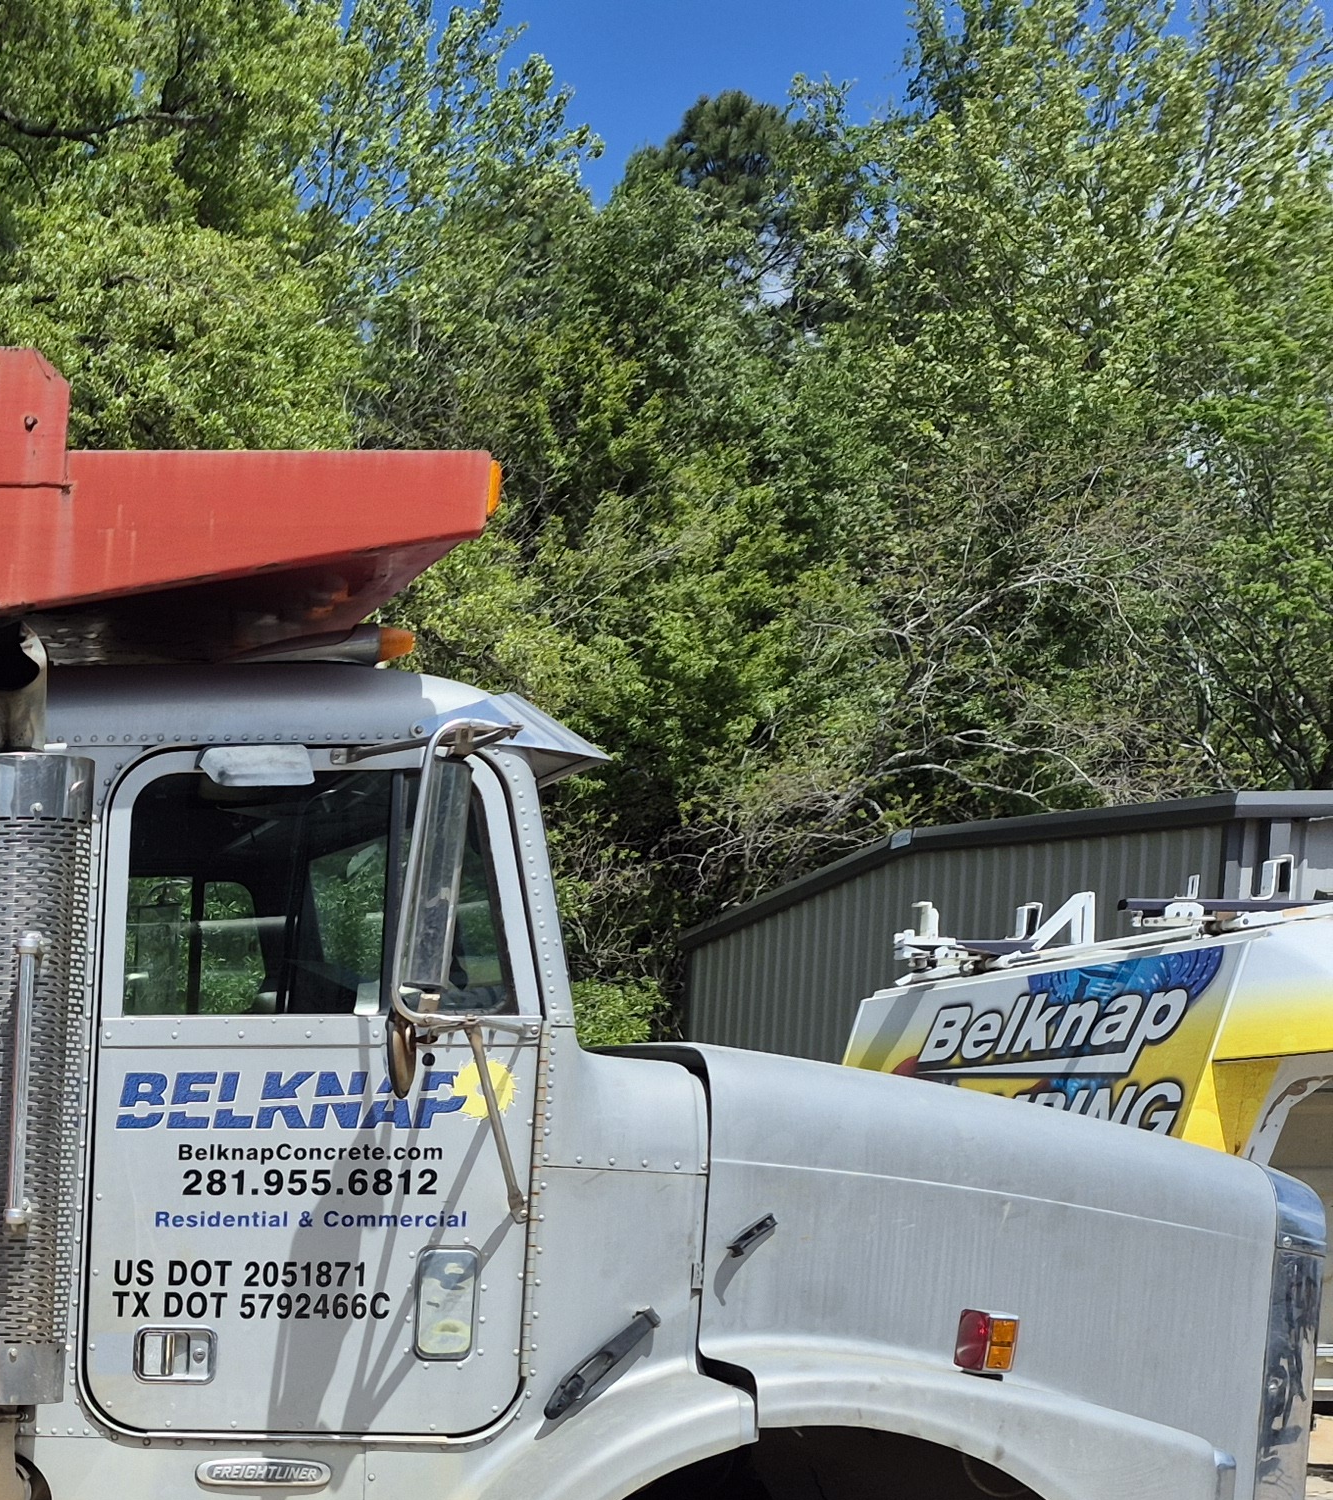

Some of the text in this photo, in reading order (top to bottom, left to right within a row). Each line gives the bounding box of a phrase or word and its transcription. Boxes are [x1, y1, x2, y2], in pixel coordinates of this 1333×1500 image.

[918, 988, 1187, 1066] Belknap
[115, 1071, 468, 1129] BELKNAP
[177, 1143, 444, 1164] BelknapConcrete.com
[182, 1169, 438, 1196] 281.955.6812
[154, 1210, 467, 1229] Residential & Commercial
[113, 1260, 367, 1288] US DOT 2051871
[113, 1291, 391, 1320] TX DOT 5792466C
[211, 1465, 318, 1481] FREIGHTLINER
